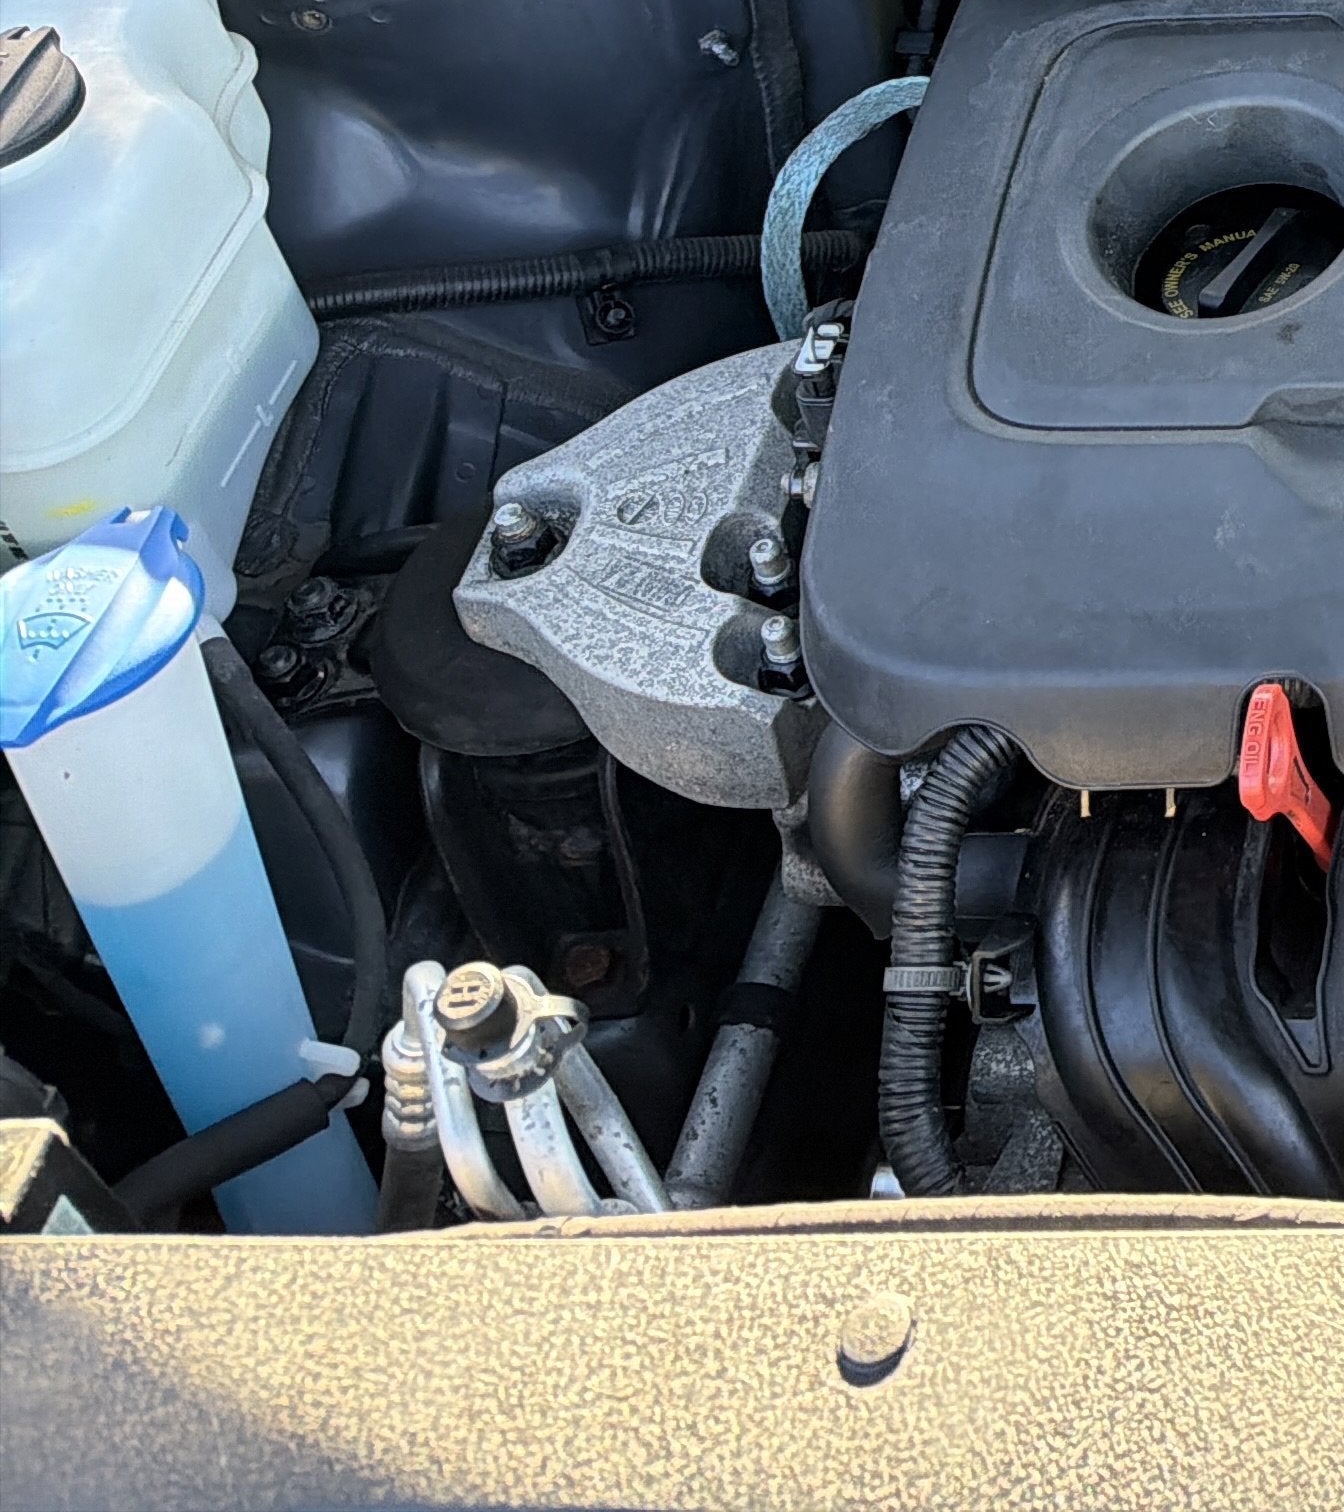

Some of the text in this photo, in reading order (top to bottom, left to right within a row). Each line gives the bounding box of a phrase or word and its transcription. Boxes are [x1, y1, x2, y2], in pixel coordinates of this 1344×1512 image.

[1164, 228, 1258, 319] SEE OWNER'S MANUA
[1258, 283, 1280, 304] SAE
[1244, 696, 1265, 774] ENG OIL
